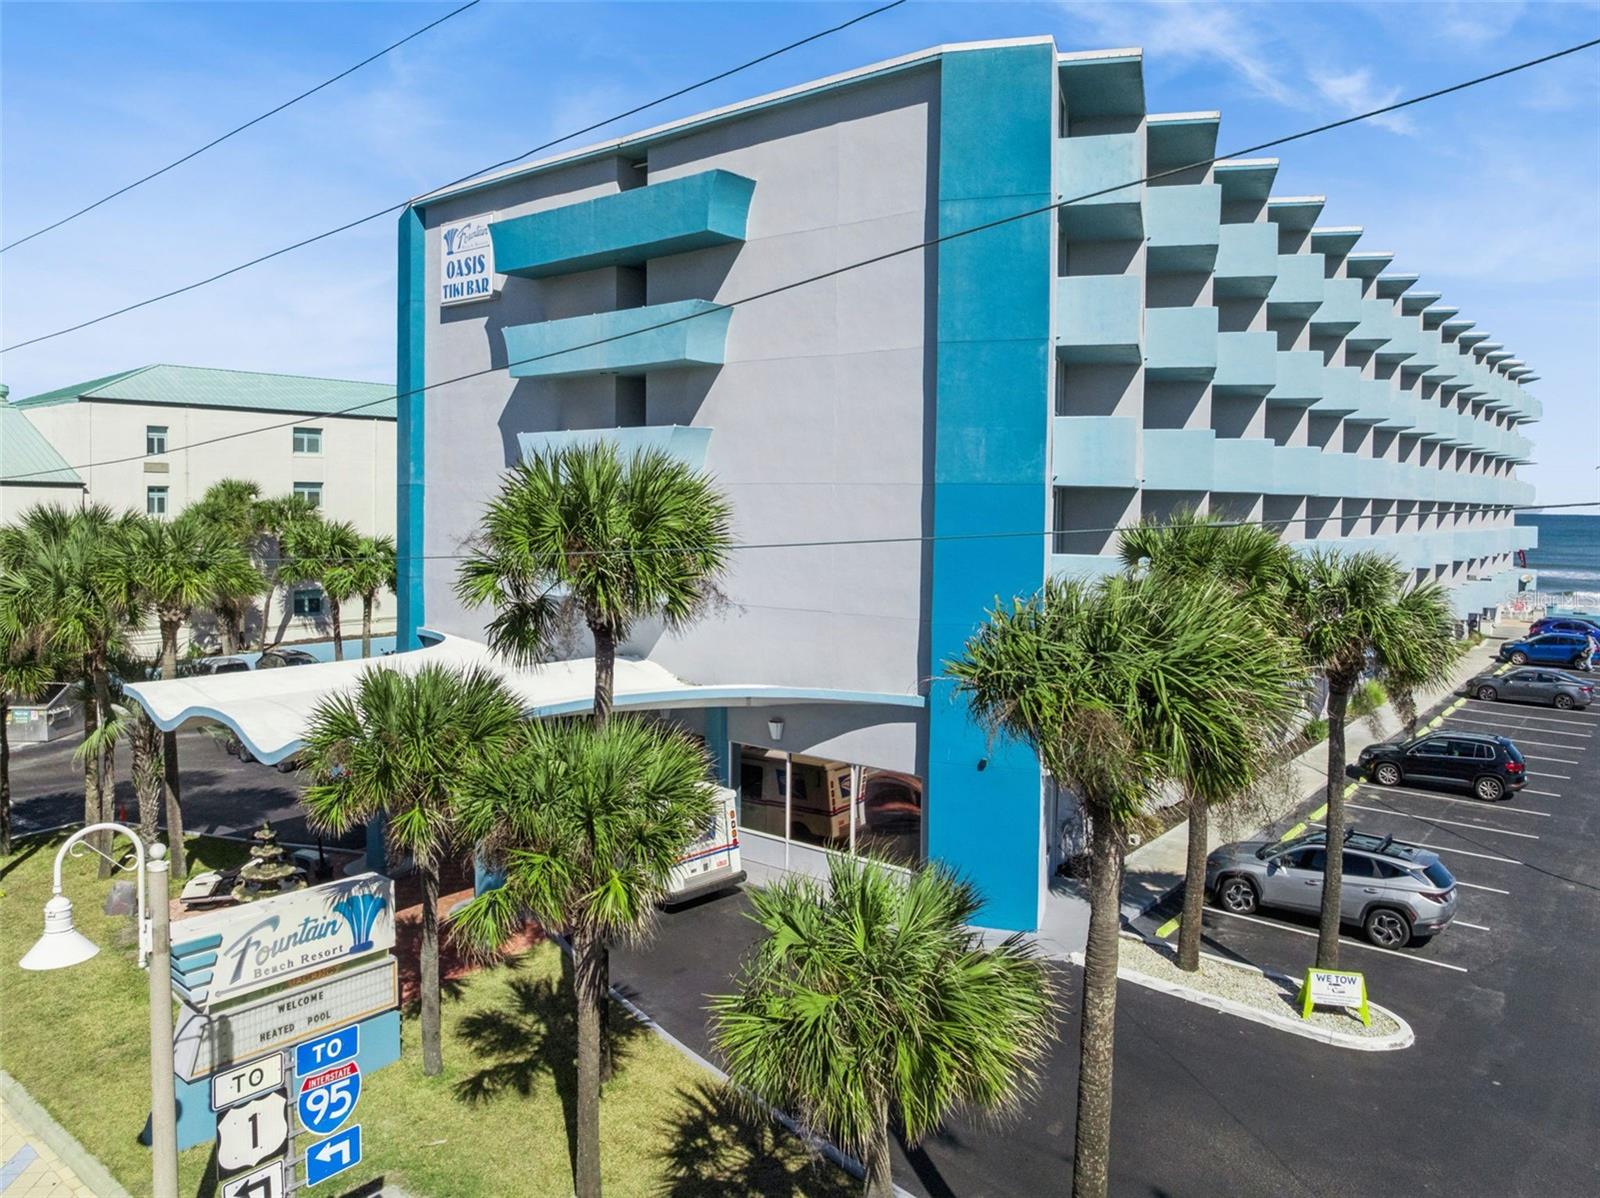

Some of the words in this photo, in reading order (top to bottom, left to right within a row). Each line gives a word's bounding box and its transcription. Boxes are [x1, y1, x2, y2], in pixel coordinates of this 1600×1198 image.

[447, 255, 485, 279] OASIS
[443, 282, 464, 299] TIKI
[466, 277, 489, 295] BAR
[224, 915, 344, 985] Fountain
[254, 960, 294, 979] Beach
[301, 945, 343, 963] Resort
[1316, 974, 1332, 982] WE
[1335, 976, 1356, 984] TOW
[278, 991, 324, 1014] WELCOME
[259, 1023, 295, 1043] HEATED
[307, 1010, 332, 1026] POOL
[312, 1038, 342, 1063] TO
[232, 1068, 264, 1093] TO
[308, 1066, 352, 1089] INTERSTATE
[306, 1079, 352, 1126] 95
[248, 1112, 259, 1150] 1
